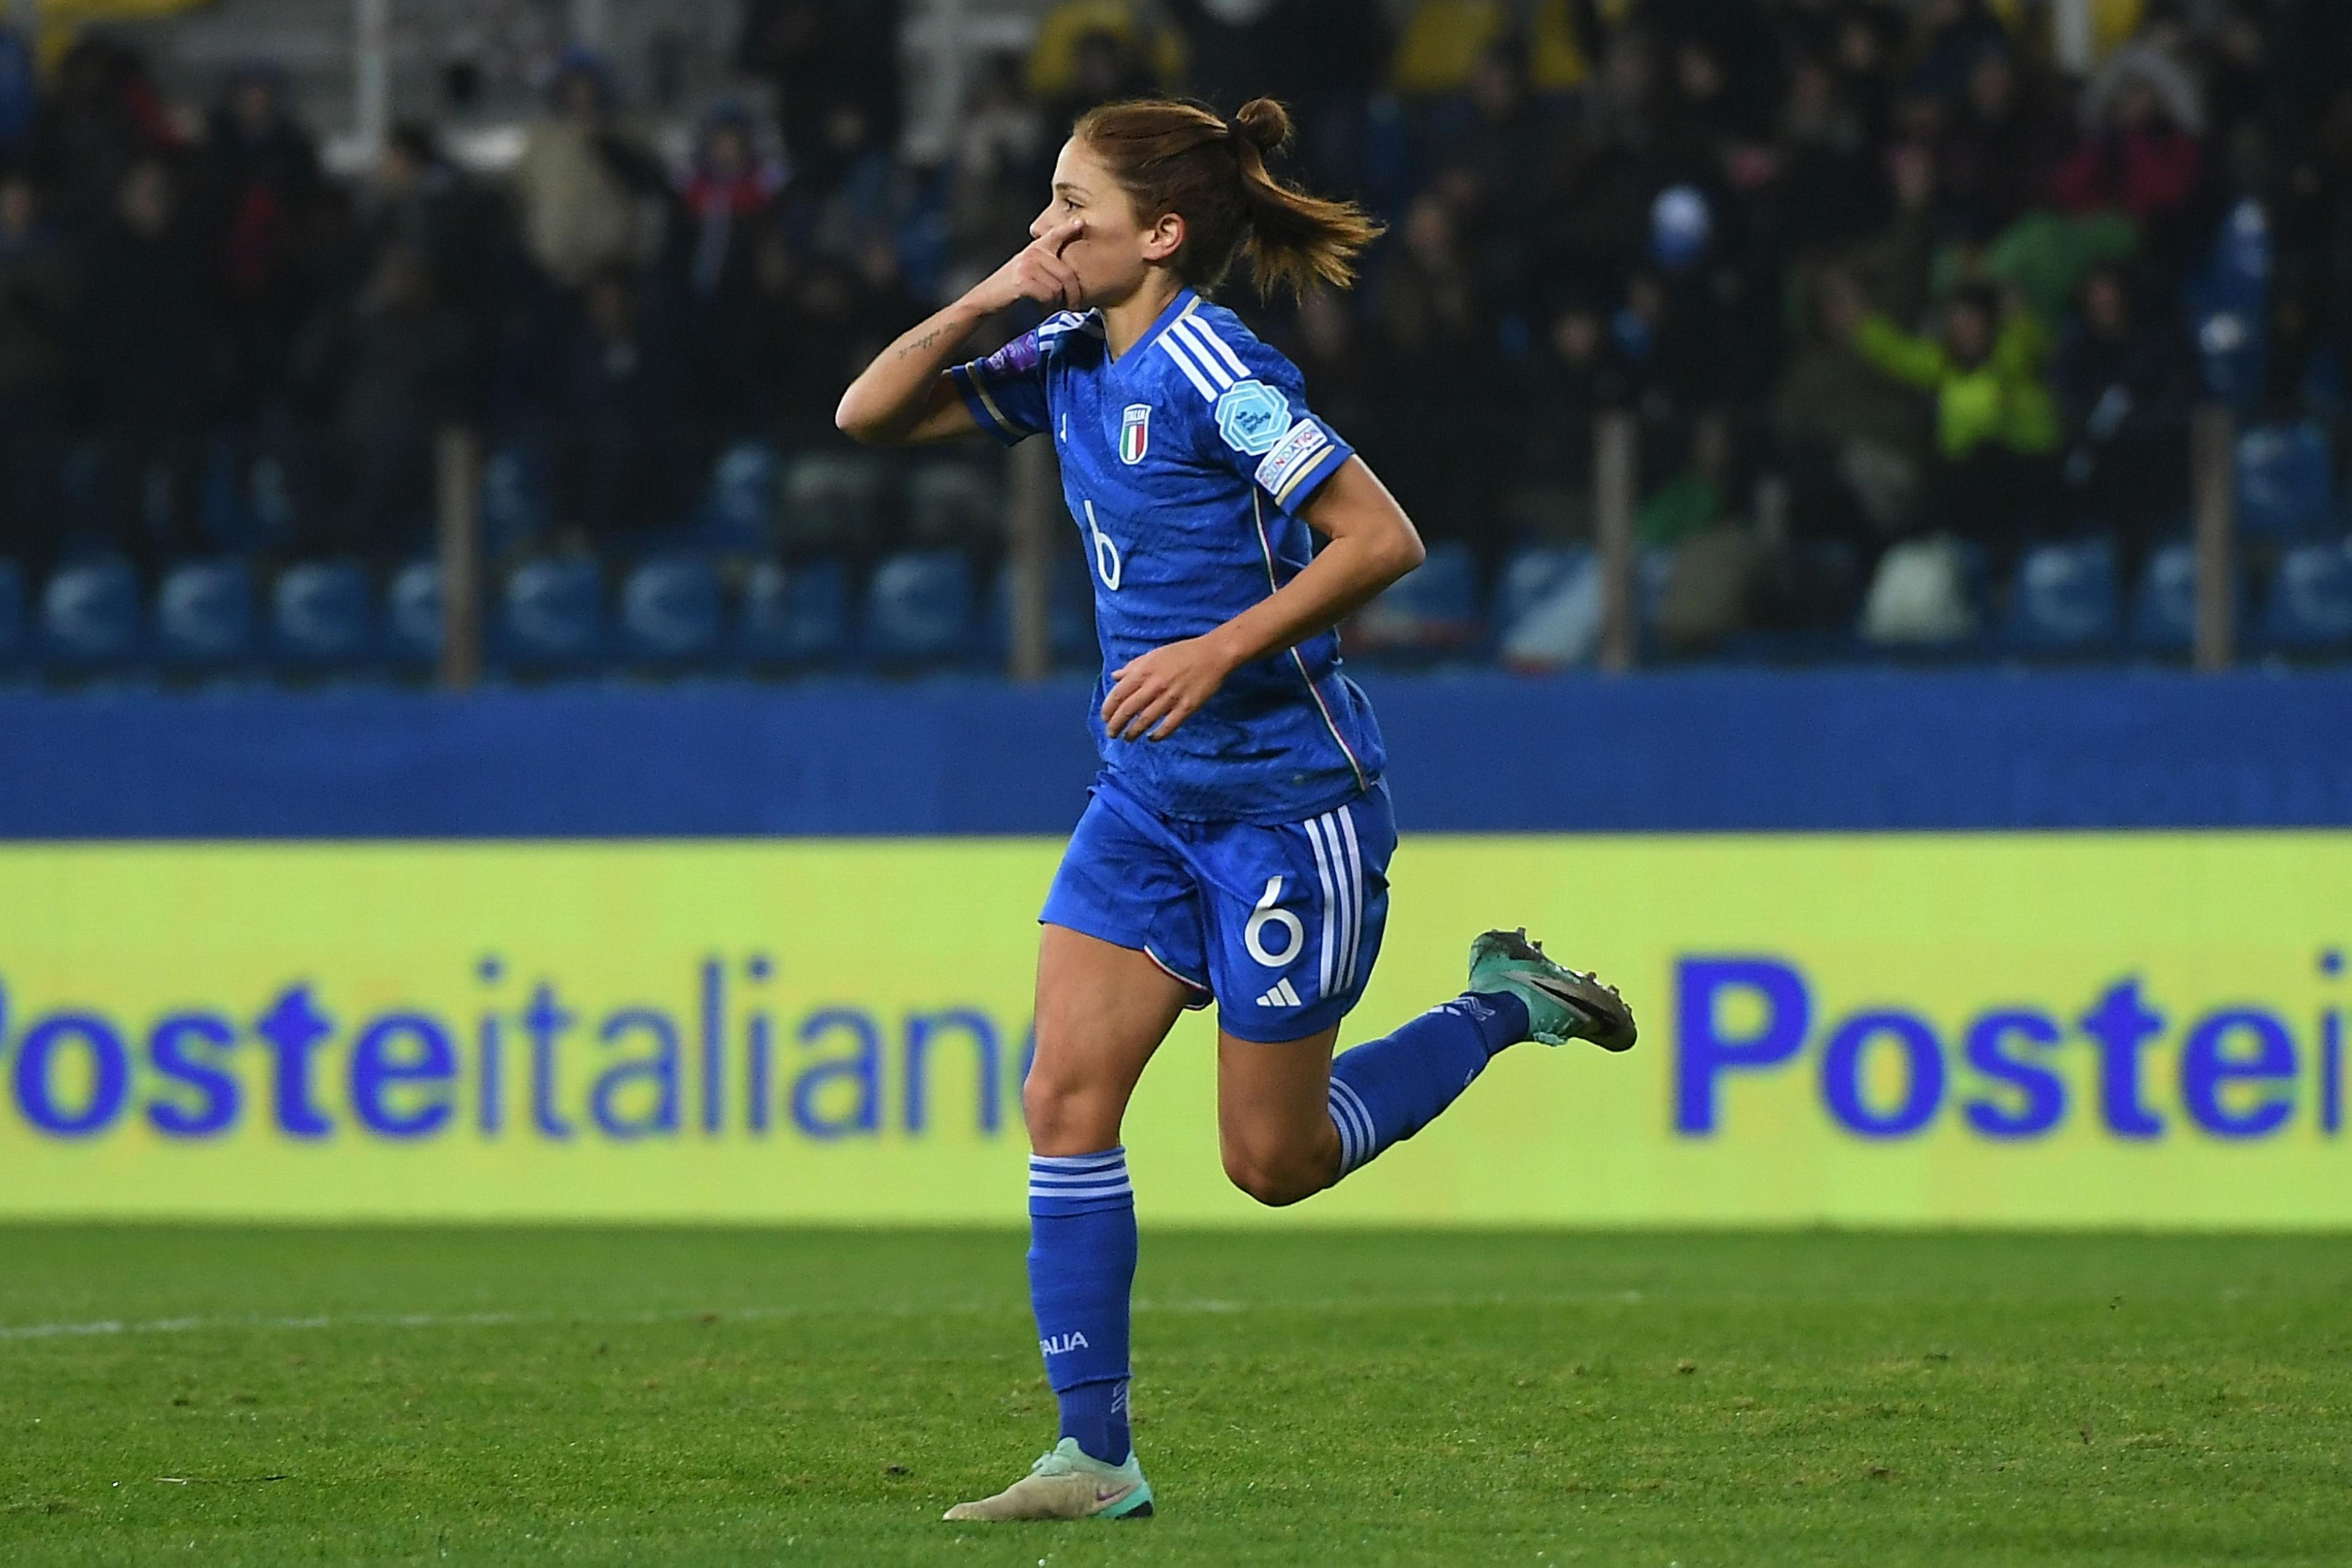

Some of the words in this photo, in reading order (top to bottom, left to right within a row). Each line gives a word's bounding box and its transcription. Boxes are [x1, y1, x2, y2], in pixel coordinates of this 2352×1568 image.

[1084, 499, 1121, 591] 6
[1244, 875, 1304, 967] 6
[0, 956, 1031, 1144] osteitalian
[1039, 1331, 1089, 1358] ALIA
